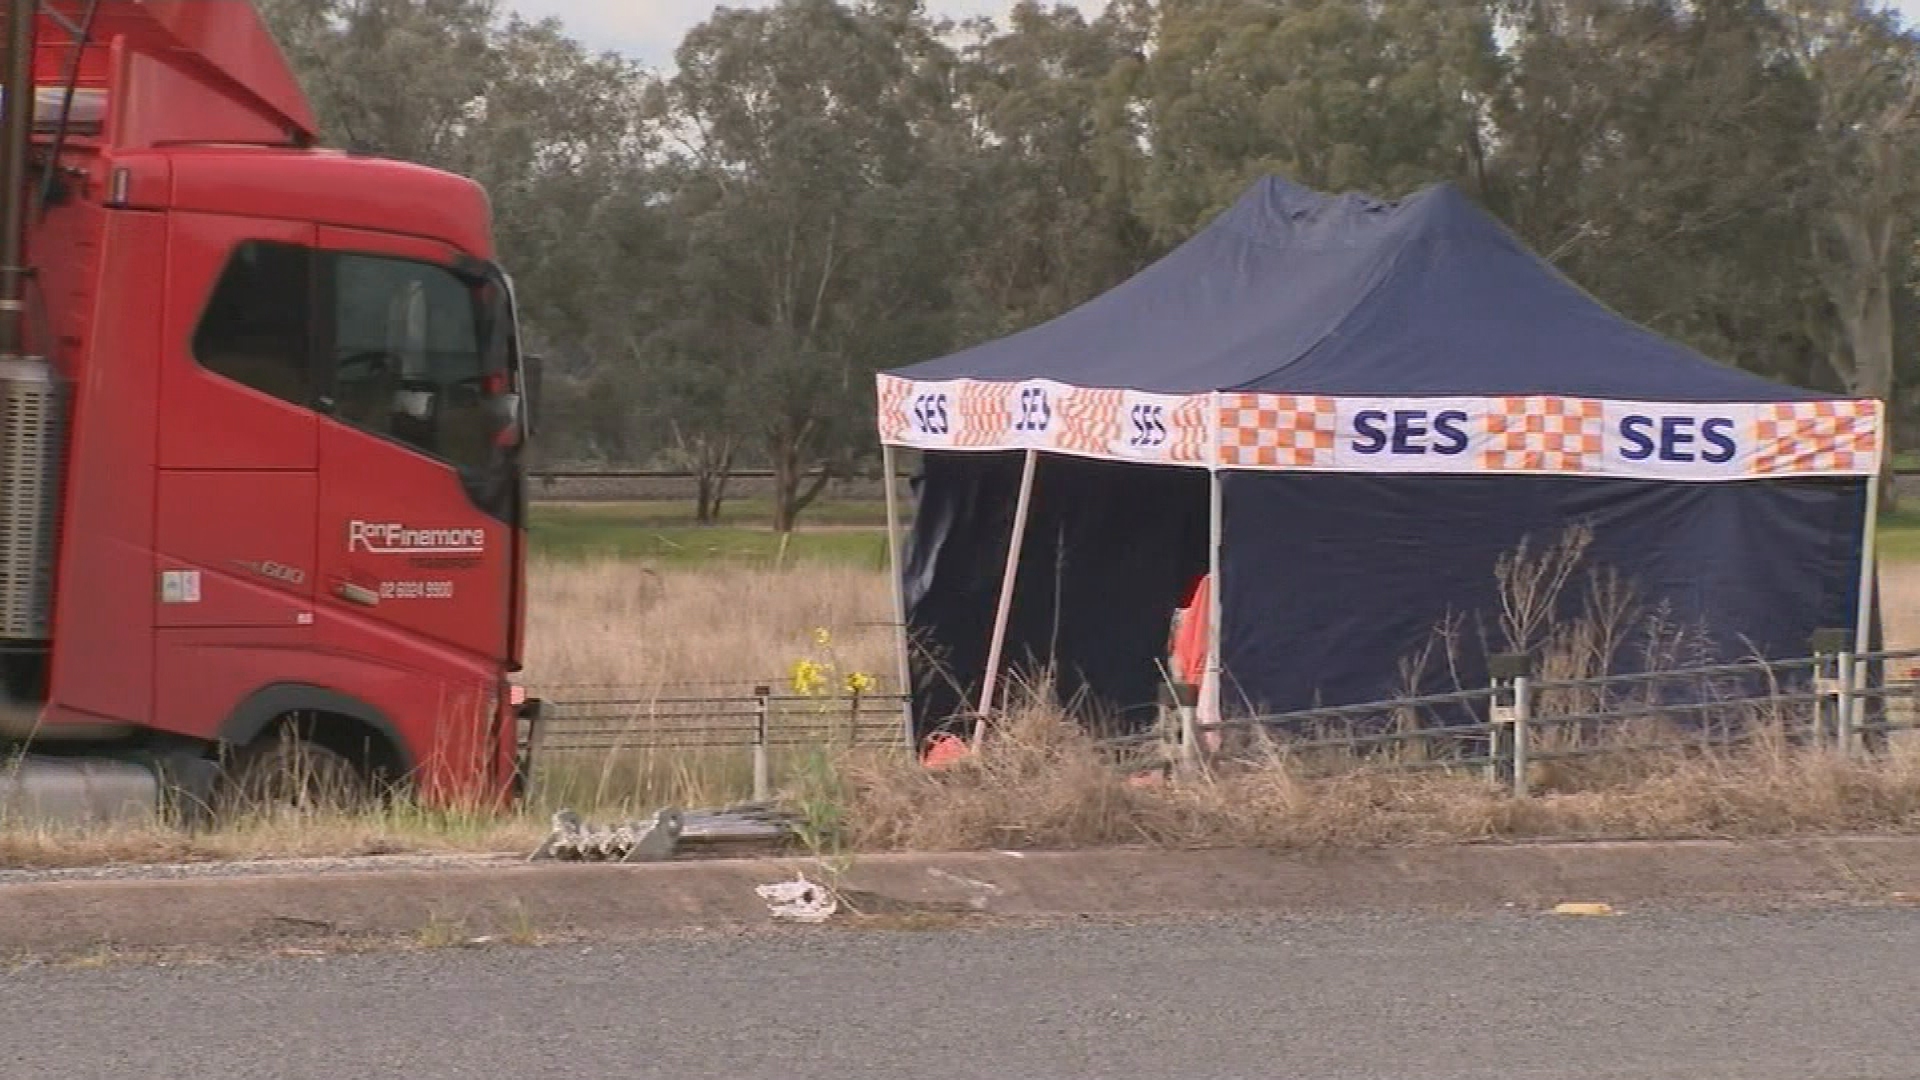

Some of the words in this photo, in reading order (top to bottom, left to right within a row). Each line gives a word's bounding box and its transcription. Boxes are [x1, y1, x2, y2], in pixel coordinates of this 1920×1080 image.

[914, 394, 949, 434] SES
[1016, 387, 1051, 431] SES
[1130, 405, 1167, 446] SES
[1352, 409, 1469, 456] SES
[1618, 415, 1738, 463] SES
[379, 581, 394, 598] 02
